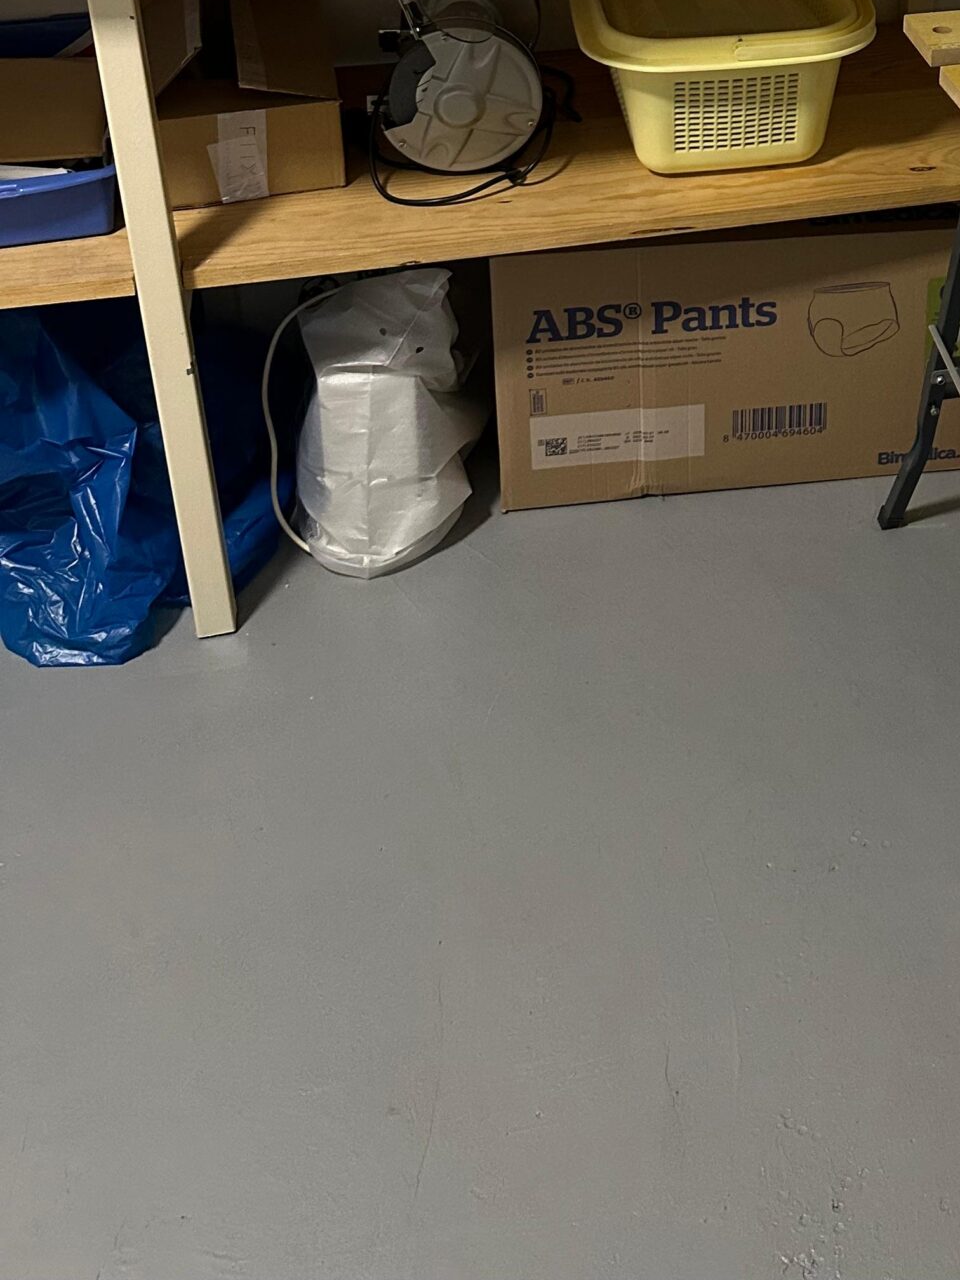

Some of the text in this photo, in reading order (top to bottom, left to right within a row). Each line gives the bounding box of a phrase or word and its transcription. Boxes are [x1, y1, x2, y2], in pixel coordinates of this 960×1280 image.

[650, 296, 779, 336] Pants
[722, 426, 824, 443] 8 470004 694604
